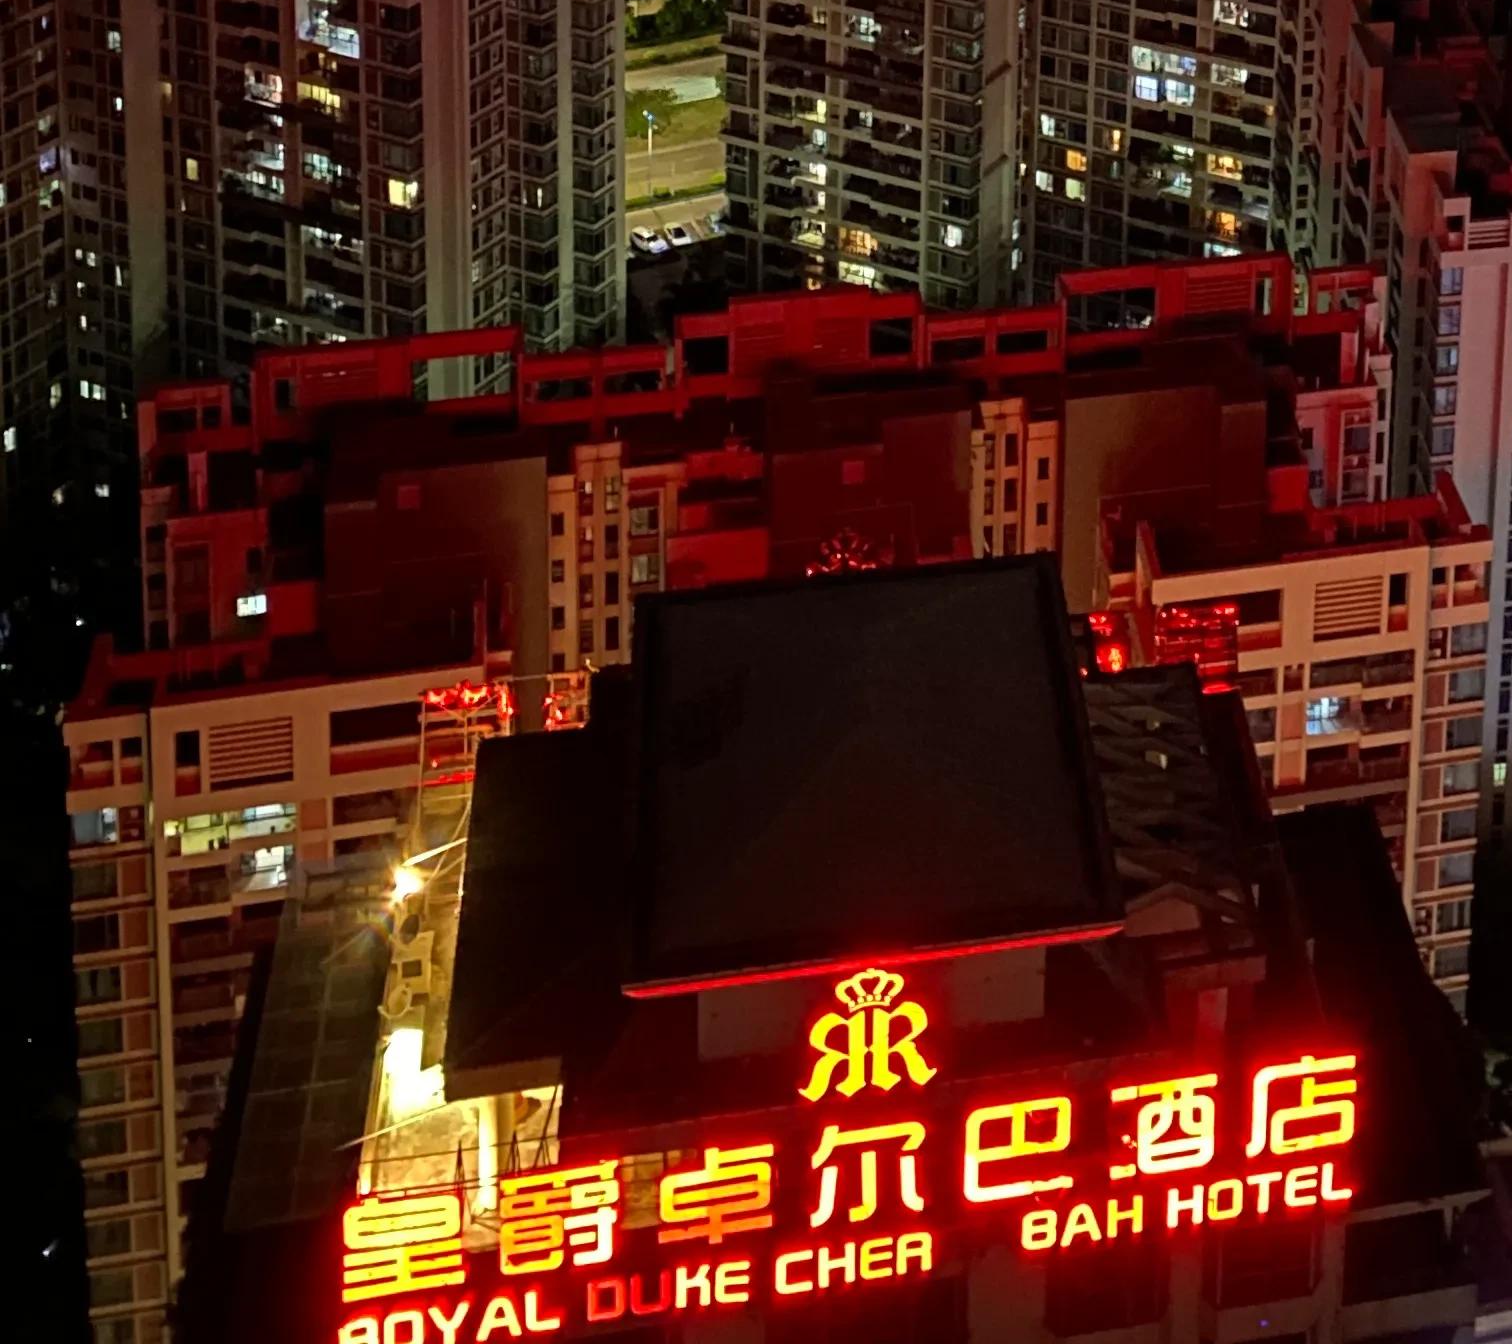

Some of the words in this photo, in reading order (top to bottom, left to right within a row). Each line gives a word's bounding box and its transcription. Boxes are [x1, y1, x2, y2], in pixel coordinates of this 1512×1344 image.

[342, 1055, 1357, 1303] 皇爵卓尔巴酒店
[587, 1260, 751, 1322] DUKE
[775, 1231, 932, 1295] CHER
[1021, 1194, 1143, 1250] BAH
[1166, 1162, 1353, 1229] HOTEL
